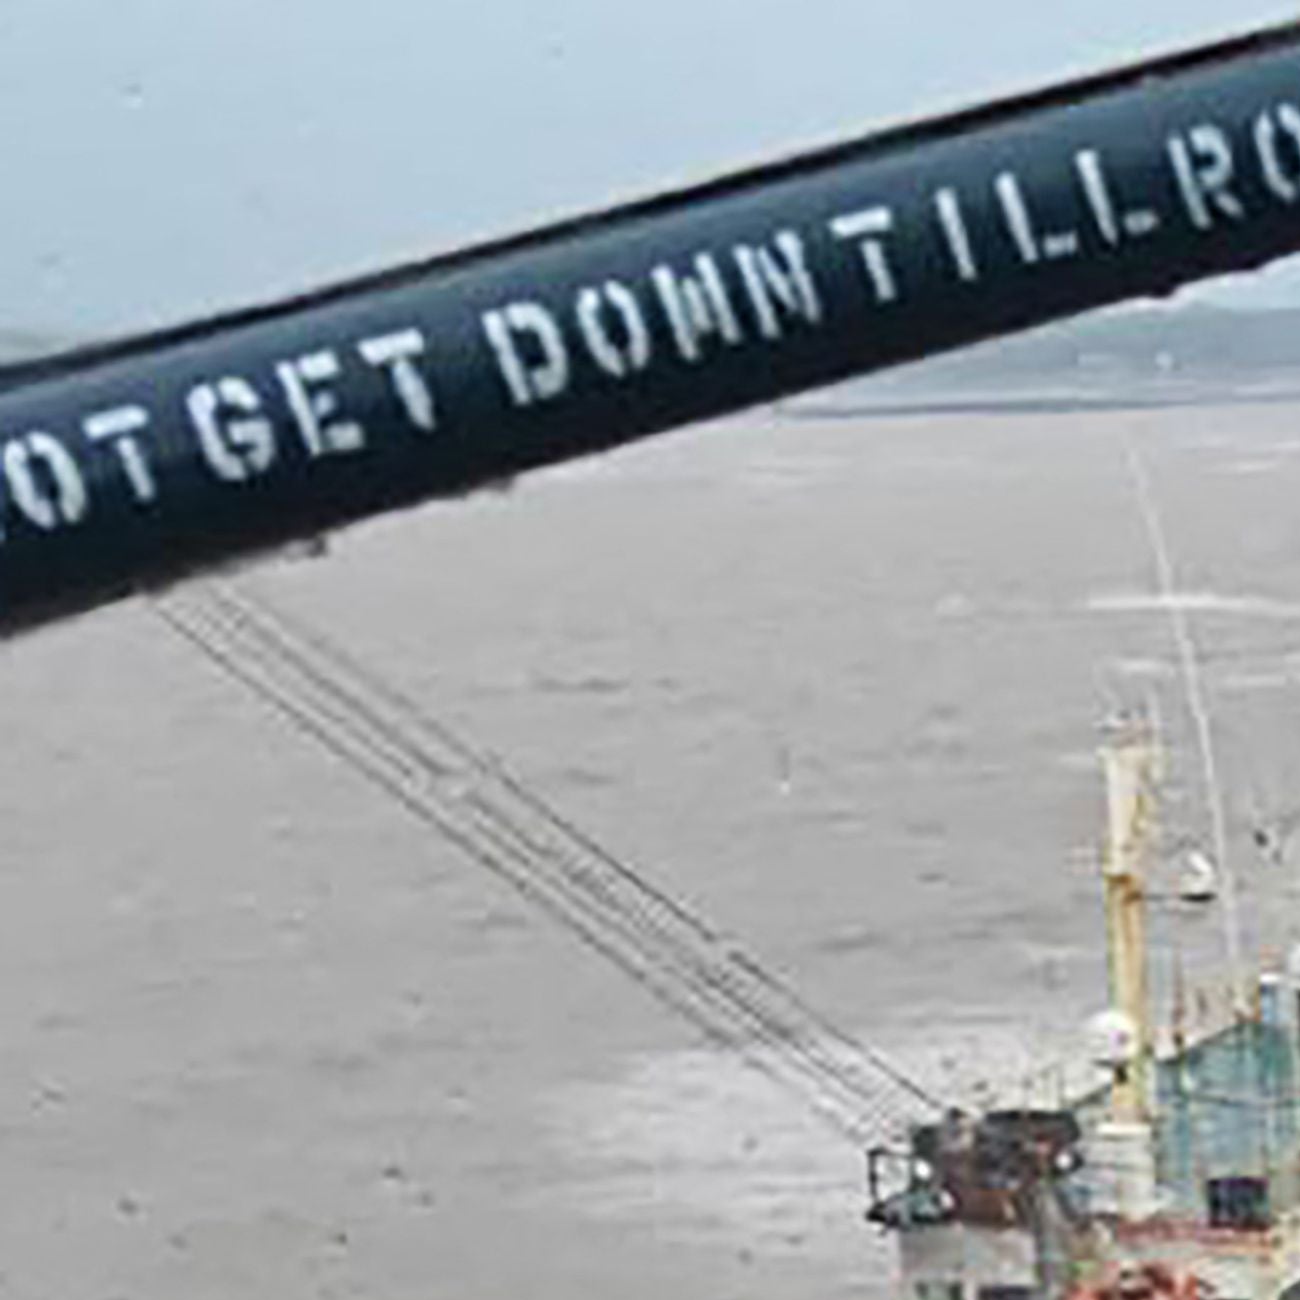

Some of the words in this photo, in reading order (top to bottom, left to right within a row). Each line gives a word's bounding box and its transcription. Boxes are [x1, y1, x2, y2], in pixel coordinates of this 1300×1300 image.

[0, 402, 156, 541] OT
[186, 328, 437, 481] GET
[482, 229, 823, 406] DOWN
[829, 148, 1161, 302] TILL
